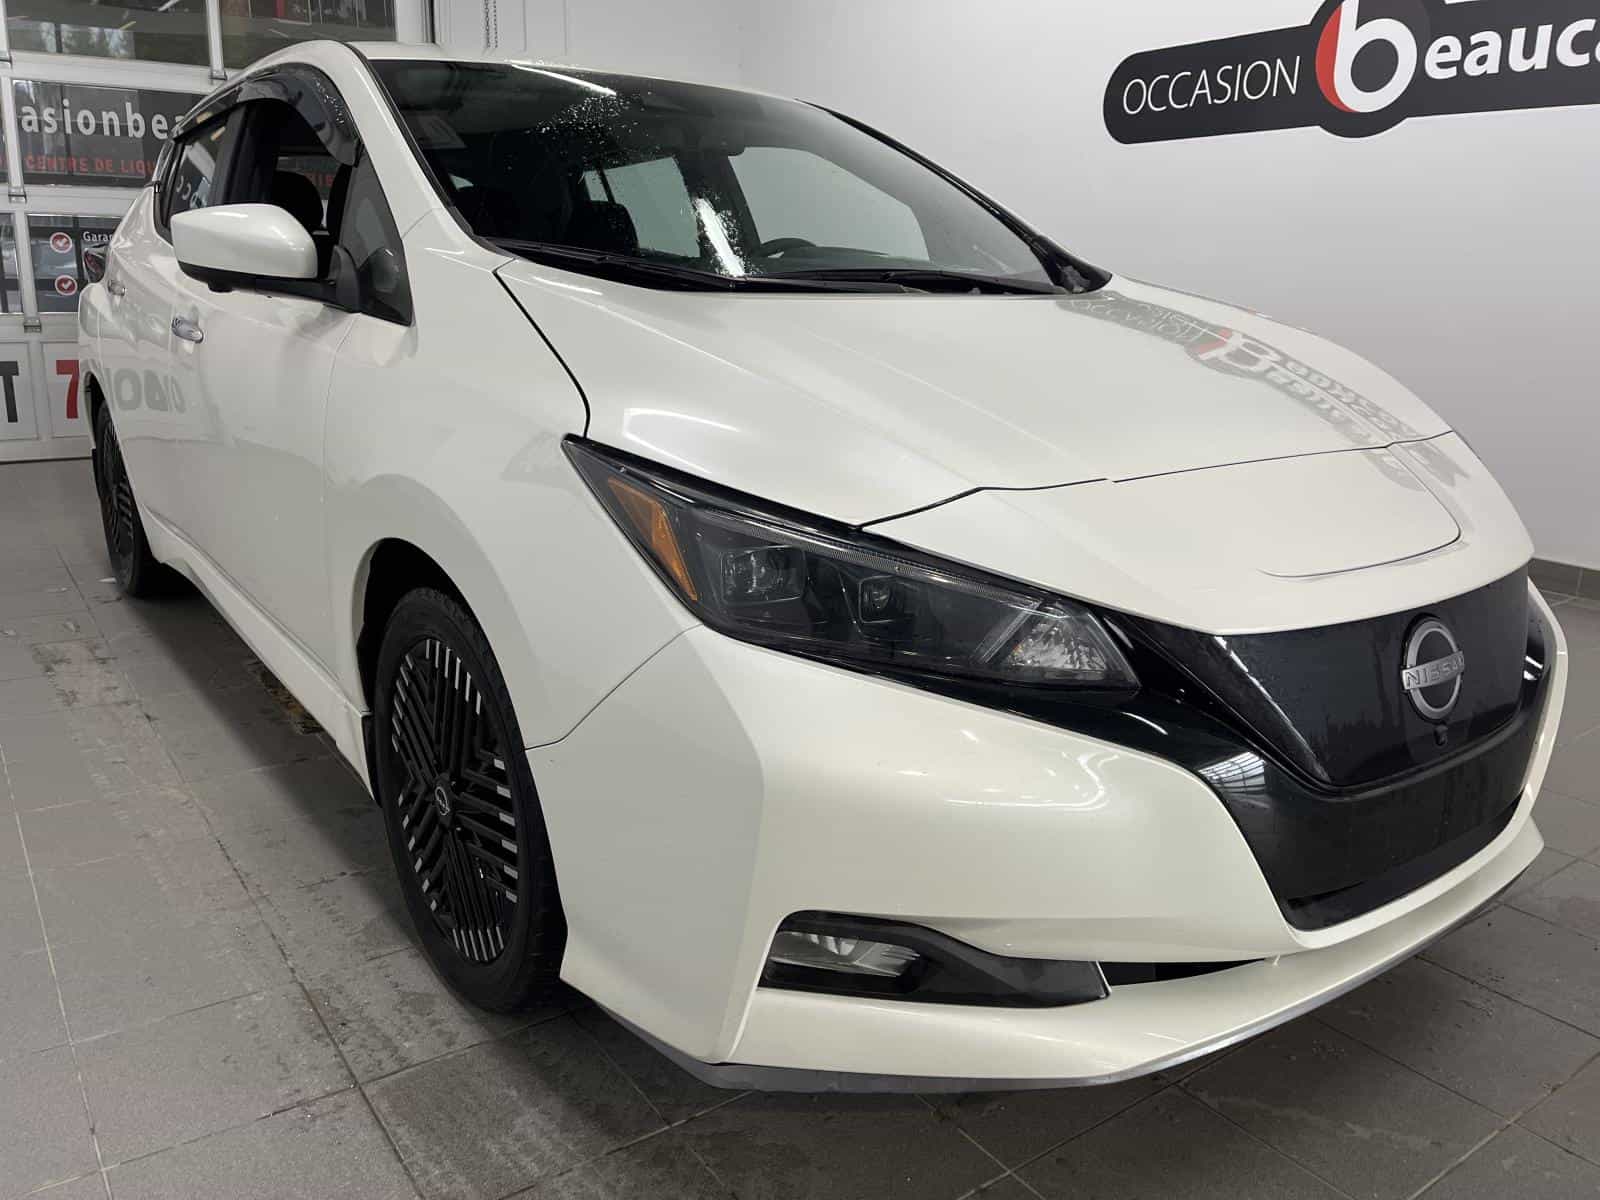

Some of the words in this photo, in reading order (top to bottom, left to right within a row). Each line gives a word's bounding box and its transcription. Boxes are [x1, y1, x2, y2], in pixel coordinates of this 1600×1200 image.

[1122, 55, 1301, 116] OCCASION
[1333, 0, 1600, 114] beauc
[25, 155, 89, 173] CENTRE
[95, 159, 113, 173] DE
[56, 360, 80, 419] 7
